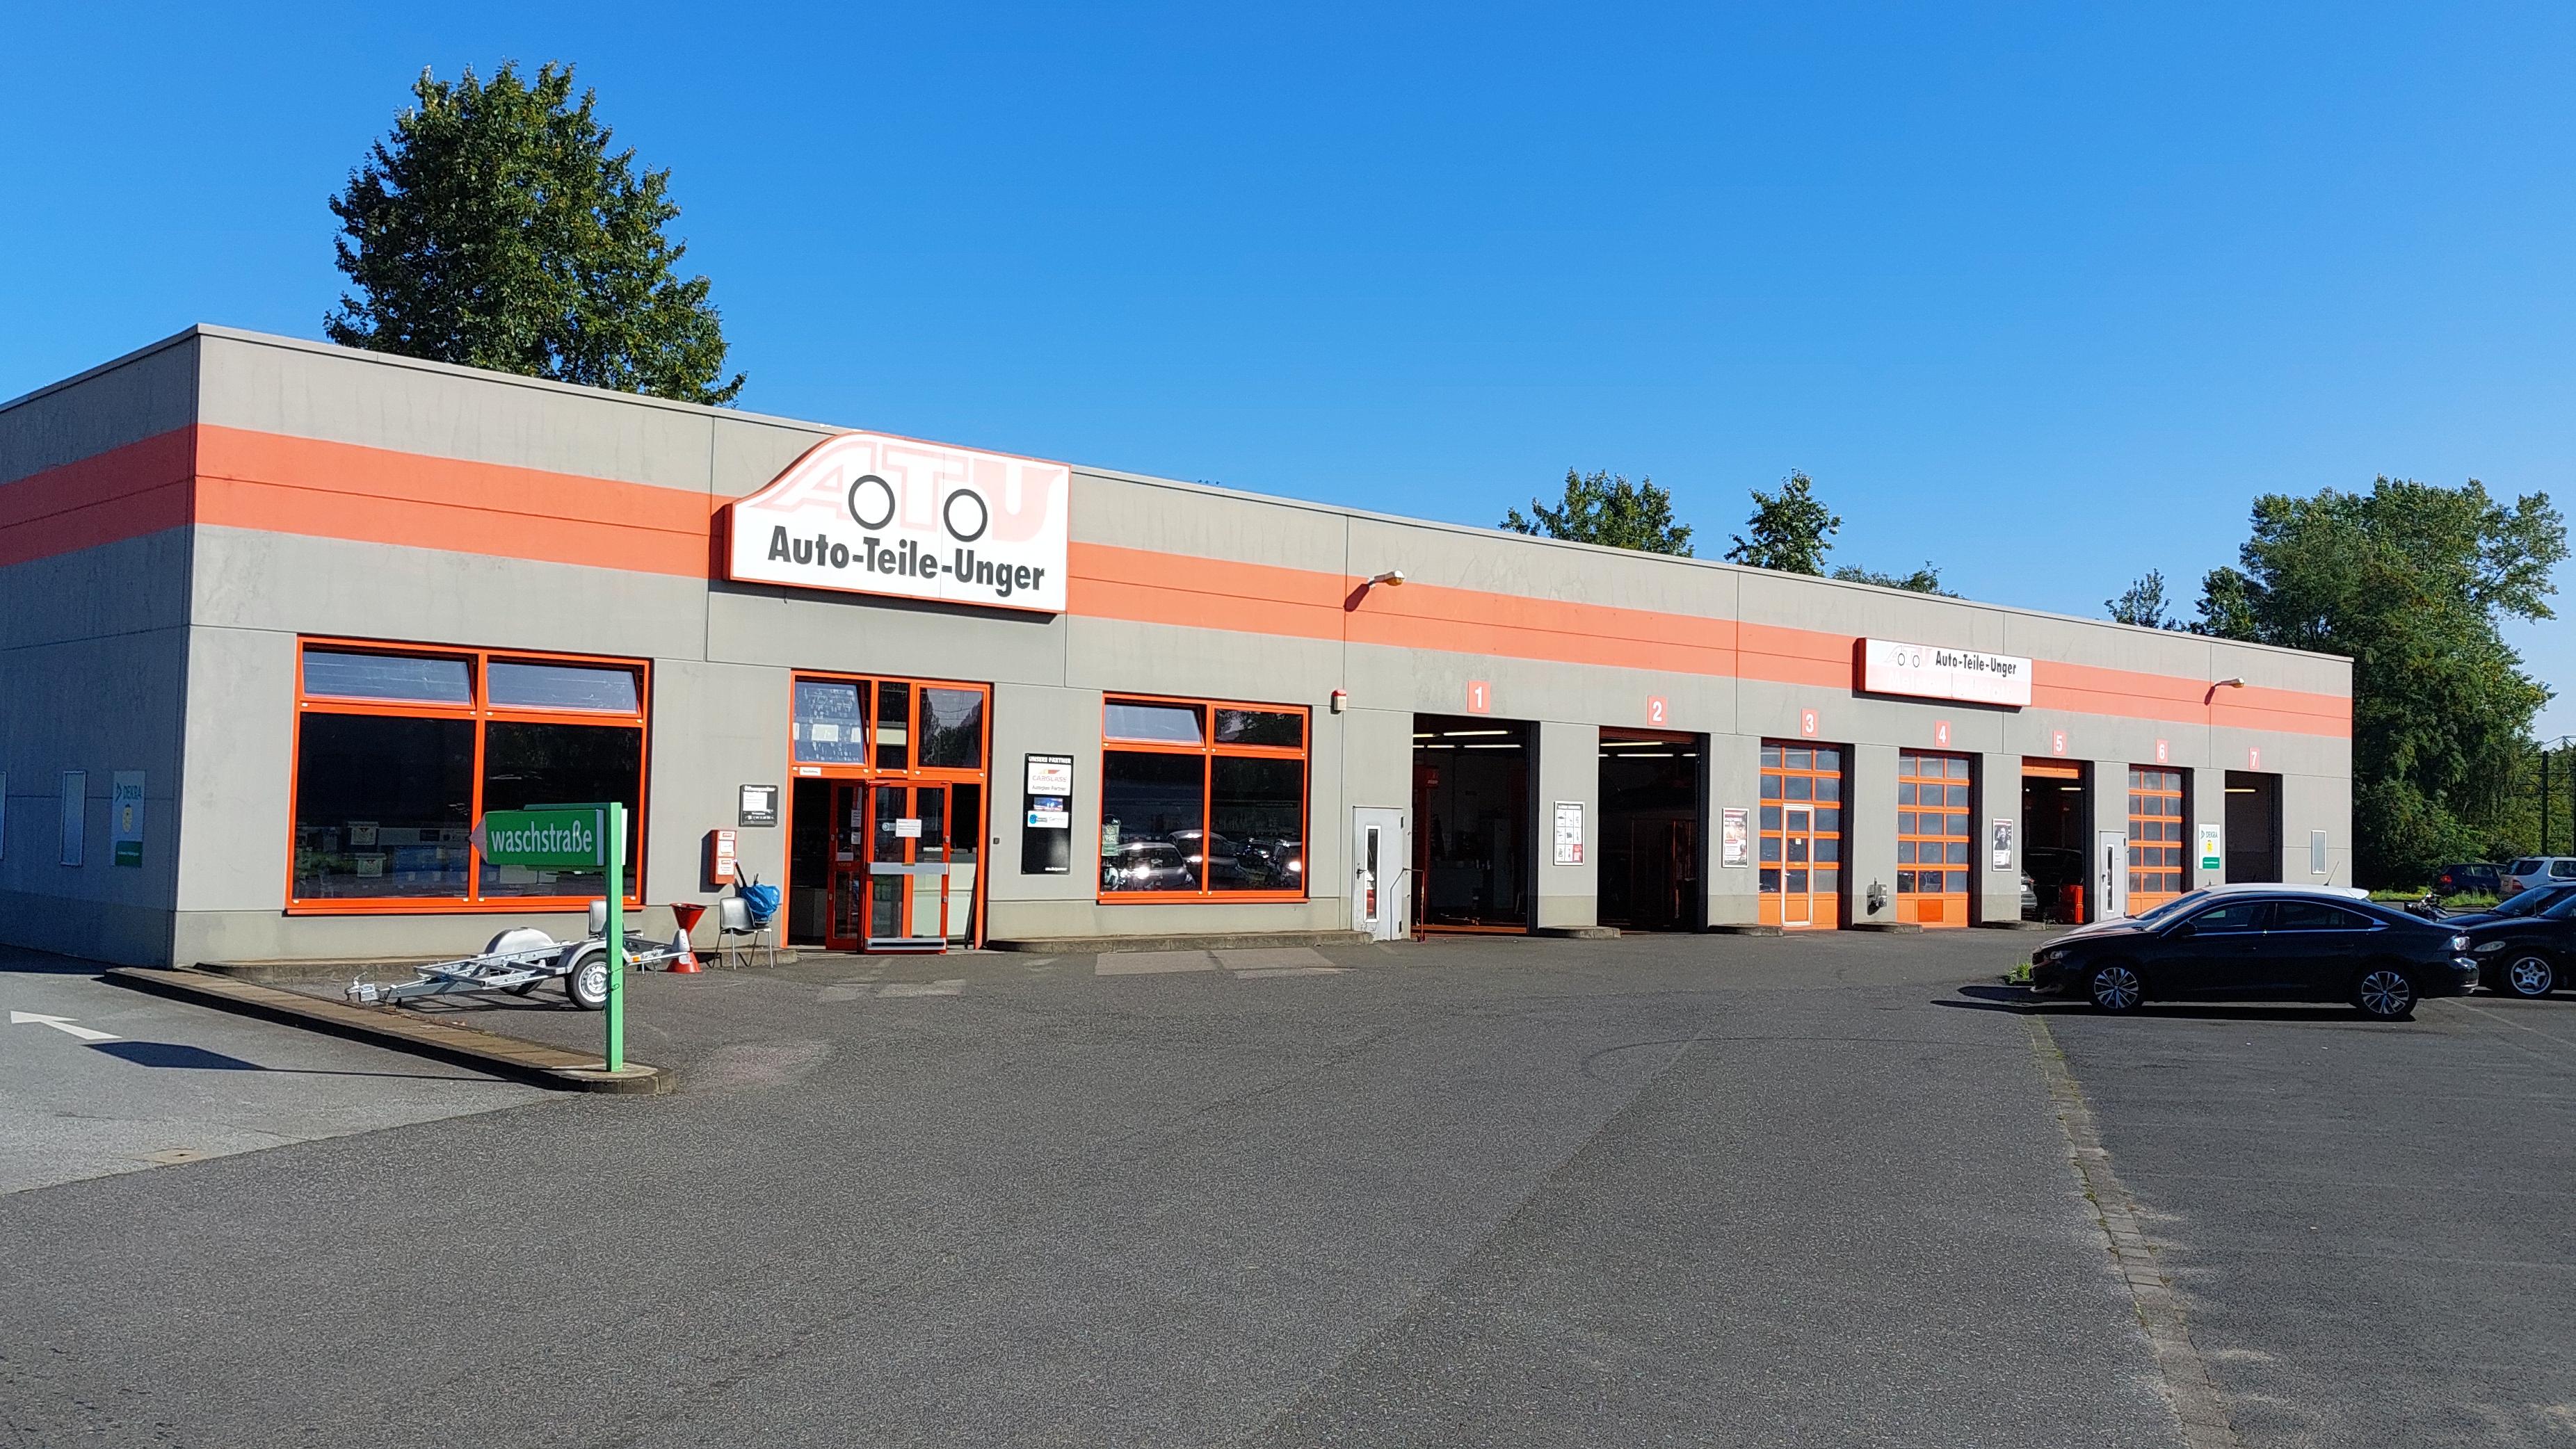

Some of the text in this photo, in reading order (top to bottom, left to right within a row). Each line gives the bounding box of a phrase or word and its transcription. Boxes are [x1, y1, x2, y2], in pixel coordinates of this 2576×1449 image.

[767, 525, 1045, 598] Auto-Teile-Unger
[1935, 650, 2017, 678] Auto-Teile-Unger
[1474, 686, 1482, 709] 1
[1652, 701, 1663, 722] 2
[1805, 713, 1814, 734] 3
[1938, 725, 1947, 743] 4
[2055, 735, 2063, 752] 5
[2159, 744, 2166, 760] 6
[2251, 751, 2257, 767] 7
[491, 820, 593, 852] waschstraße
